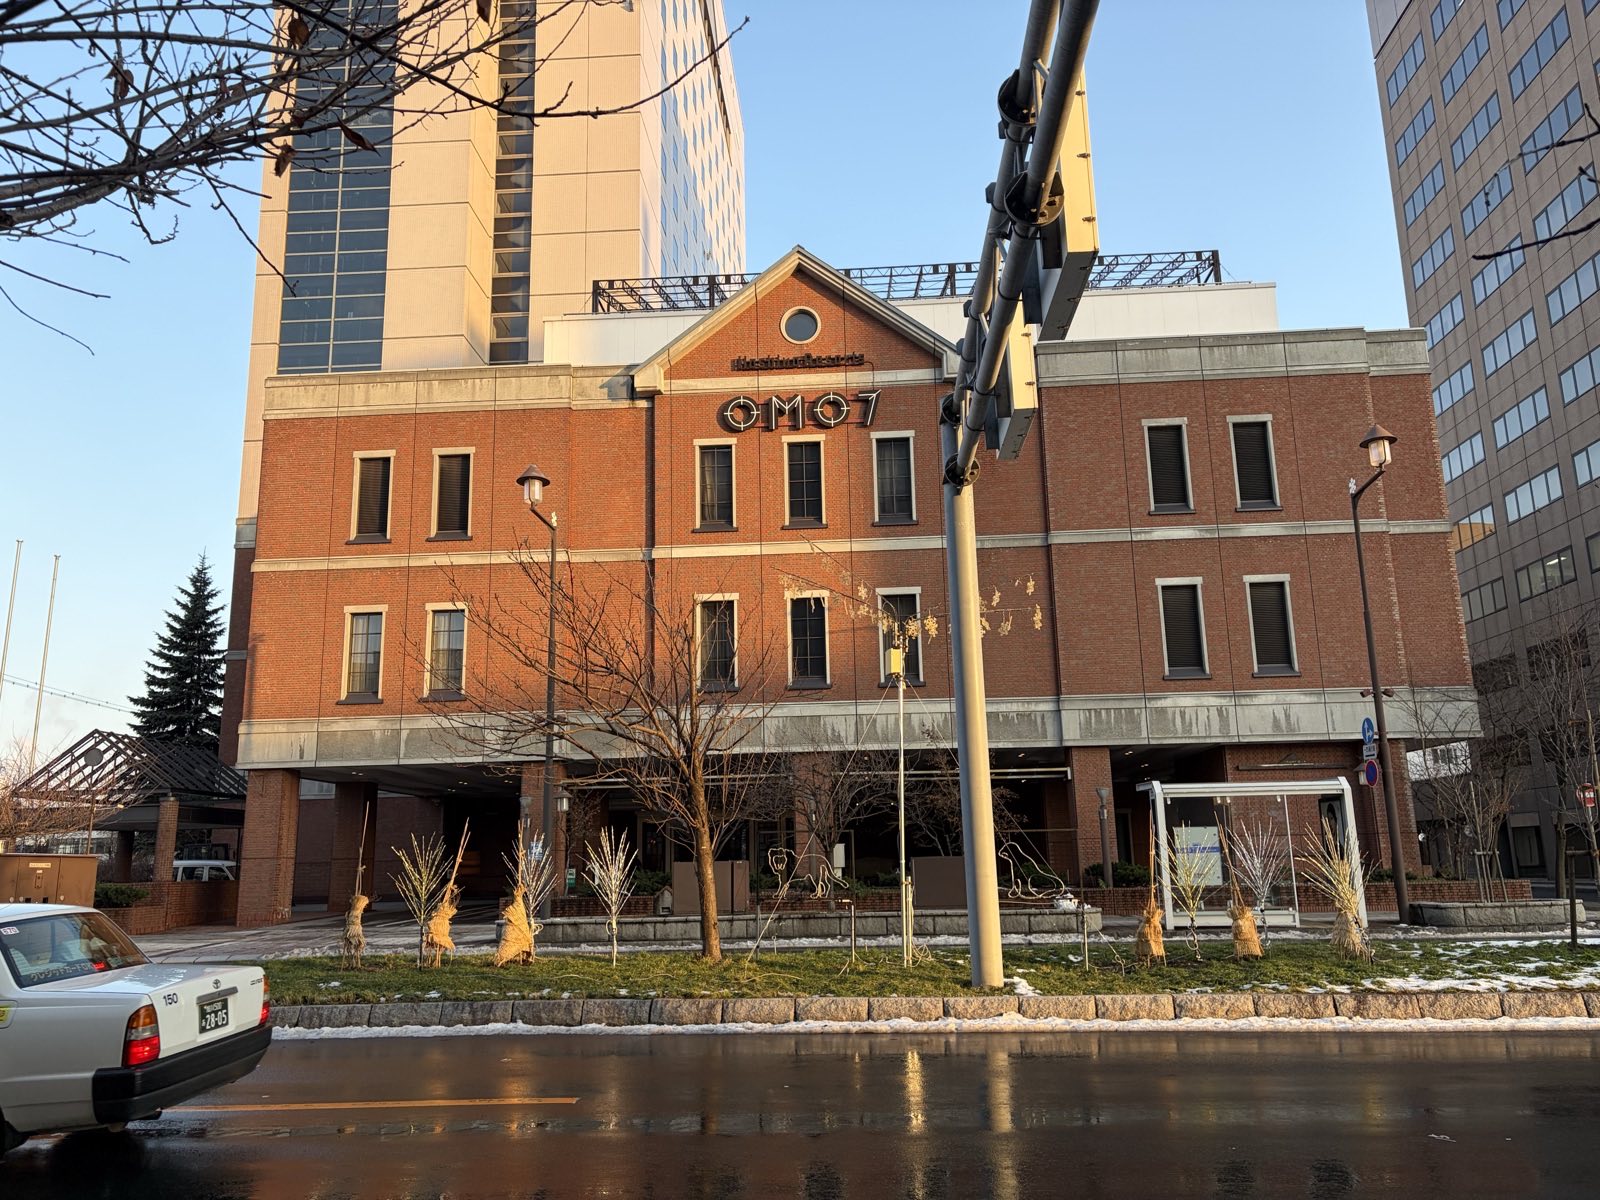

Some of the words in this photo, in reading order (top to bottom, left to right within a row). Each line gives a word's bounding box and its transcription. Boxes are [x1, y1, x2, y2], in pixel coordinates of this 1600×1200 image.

[722, 389, 882, 432] OMO7
[163, 993, 179, 1006] 150
[206, 1010, 227, 1030] 28-05
